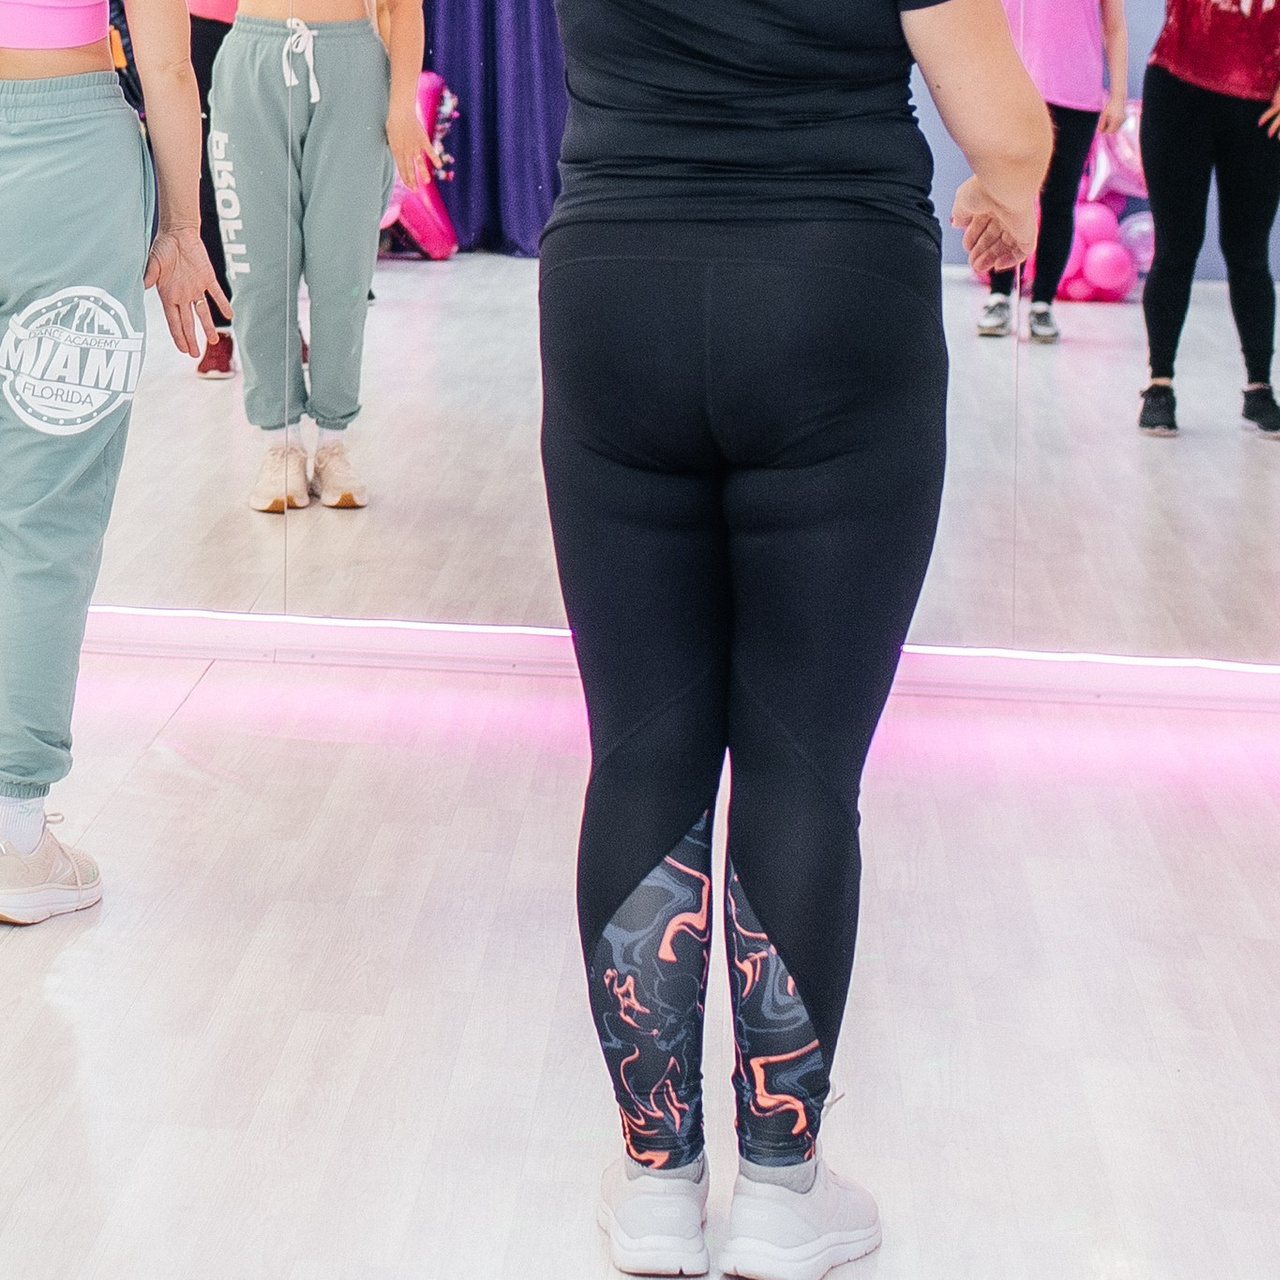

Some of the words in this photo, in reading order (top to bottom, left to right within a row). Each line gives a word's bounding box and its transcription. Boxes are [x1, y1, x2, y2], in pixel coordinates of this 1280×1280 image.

[28, 326, 64, 340] DANCE
[65, 334, 121, 350] ACADEMY
[22, 383, 94, 407] FLORIDA
